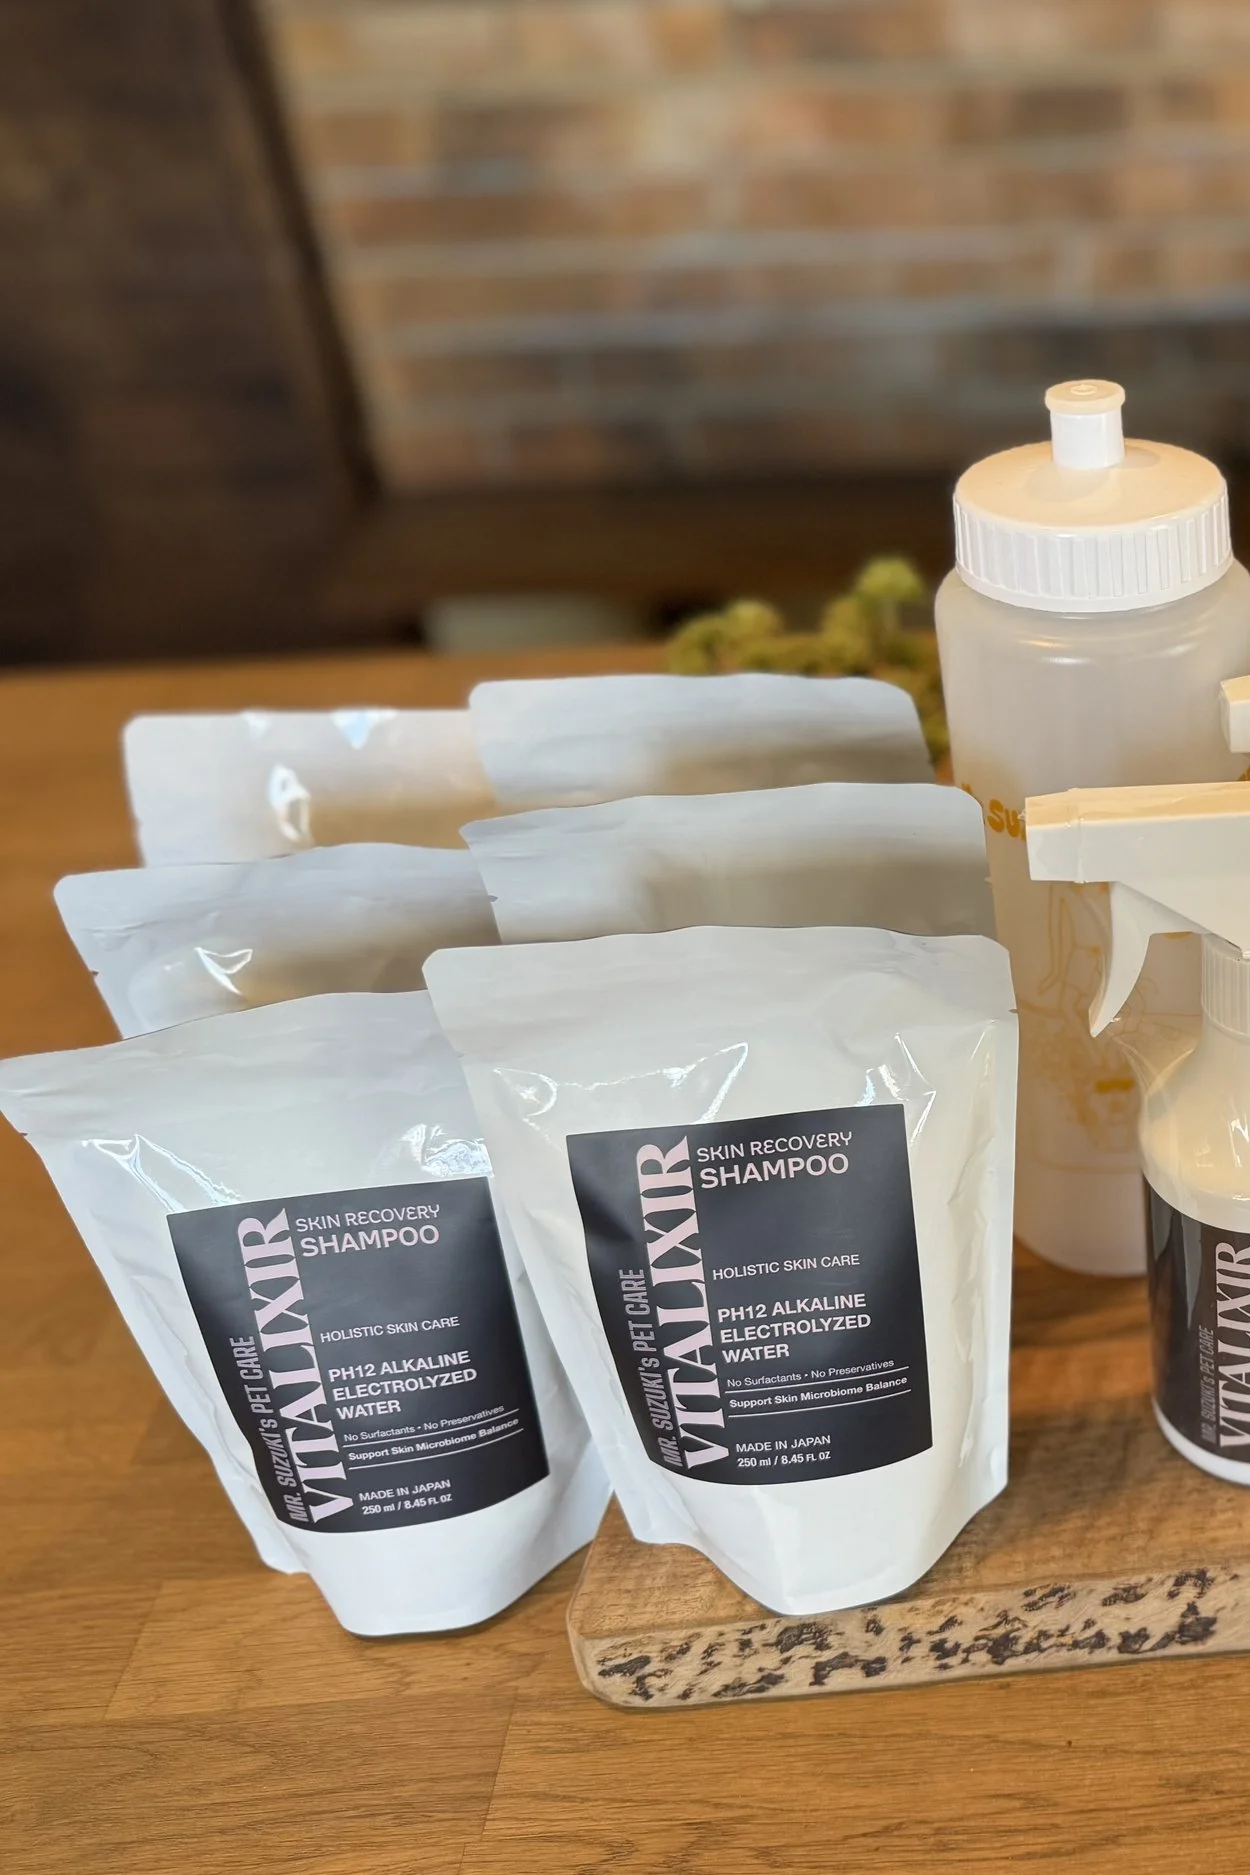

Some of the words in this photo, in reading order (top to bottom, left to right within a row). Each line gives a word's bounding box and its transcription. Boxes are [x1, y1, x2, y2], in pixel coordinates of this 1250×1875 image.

[697, 1142, 745, 1163] SKIN
[751, 1131, 852, 1156] RECOVERY
[700, 1153, 849, 1189] SHAMPOO
[295, 1214, 340, 1233] SKIN
[345, 1204, 441, 1226] RECOVERY
[301, 1224, 440, 1258] SHAMPOO
[712, 1262, 780, 1280] HOLISTIC
[783, 1256, 818, 1272] SKIN
[821, 1254, 860, 1270] CARE
[619, 1268, 651, 1317] CARE
[636, 1136, 730, 1470] VITALIXIR
[717, 1303, 767, 1323] PH12
[771, 1293, 866, 1317] ALKALINE
[320, 1325, 384, 1343] HOLISTIC
[387, 1320, 419, 1335] SKIN
[421, 1316, 460, 1330] CARE
[628, 1320, 657, 1352] PET
[720, 1313, 871, 1343] ELECTROLYZED
[1199, 1324, 1214, 1355] CARE
[230, 1335, 264, 1381] CARE
[237, 1208, 354, 1523] VITALIXIR
[329, 1363, 377, 1382] PH12
[380, 1350, 471, 1375] ALKALINE
[722, 1343, 790, 1364] WATER
[1200, 1353, 1215, 1375] PET
[333, 1367, 478, 1401] ELECTROLYZED
[727, 1379, 742, 1388] No
[744, 1373, 802, 1386] Surfactants
[811, 1370, 826, 1379] No
[828, 1359, 895, 1377] Preservatives
[244, 1384, 274, 1414] PET
[638, 1357, 674, 1431] SUZUKI's
[729, 1397, 773, 1409] Support
[774, 1393, 798, 1405] Skin
[800, 1383, 864, 1402] Microbiome
[866, 1376, 908, 1392] Balance
[336, 1399, 402, 1420] WATER
[344, 1433, 359, 1442] No
[361, 1425, 415, 1440] Surfactants
[424, 1422, 438, 1431] No
[441, 1405, 505, 1428] Preservatives
[258, 1418, 297, 1488] SUZUKI's
[349, 1449, 390, 1461] Support
[391, 1444, 414, 1455] Skin
[416, 1432, 477, 1451] Microbiome
[478, 1418, 519, 1438] Balance
[658, 1435, 684, 1467] MR.
[736, 1441, 773, 1453] MADE
[776, 1440, 788, 1450] IN
[791, 1434, 832, 1449] JAPAN
[738, 1457, 757, 1468] 250
[759, 1457, 771, 1467] ml
[774, 1456, 779, 1466] /
[781, 1453, 804, 1465] 8.45
[359, 1489, 395, 1502] MADE
[397, 1487, 409, 1497] IN
[412, 1479, 451, 1494] JAPAN
[362, 1504, 382, 1515] 250
[384, 1503, 395, 1513] ml
[404, 1497, 427, 1510] 8.45
[283, 1492, 309, 1522] MR.
